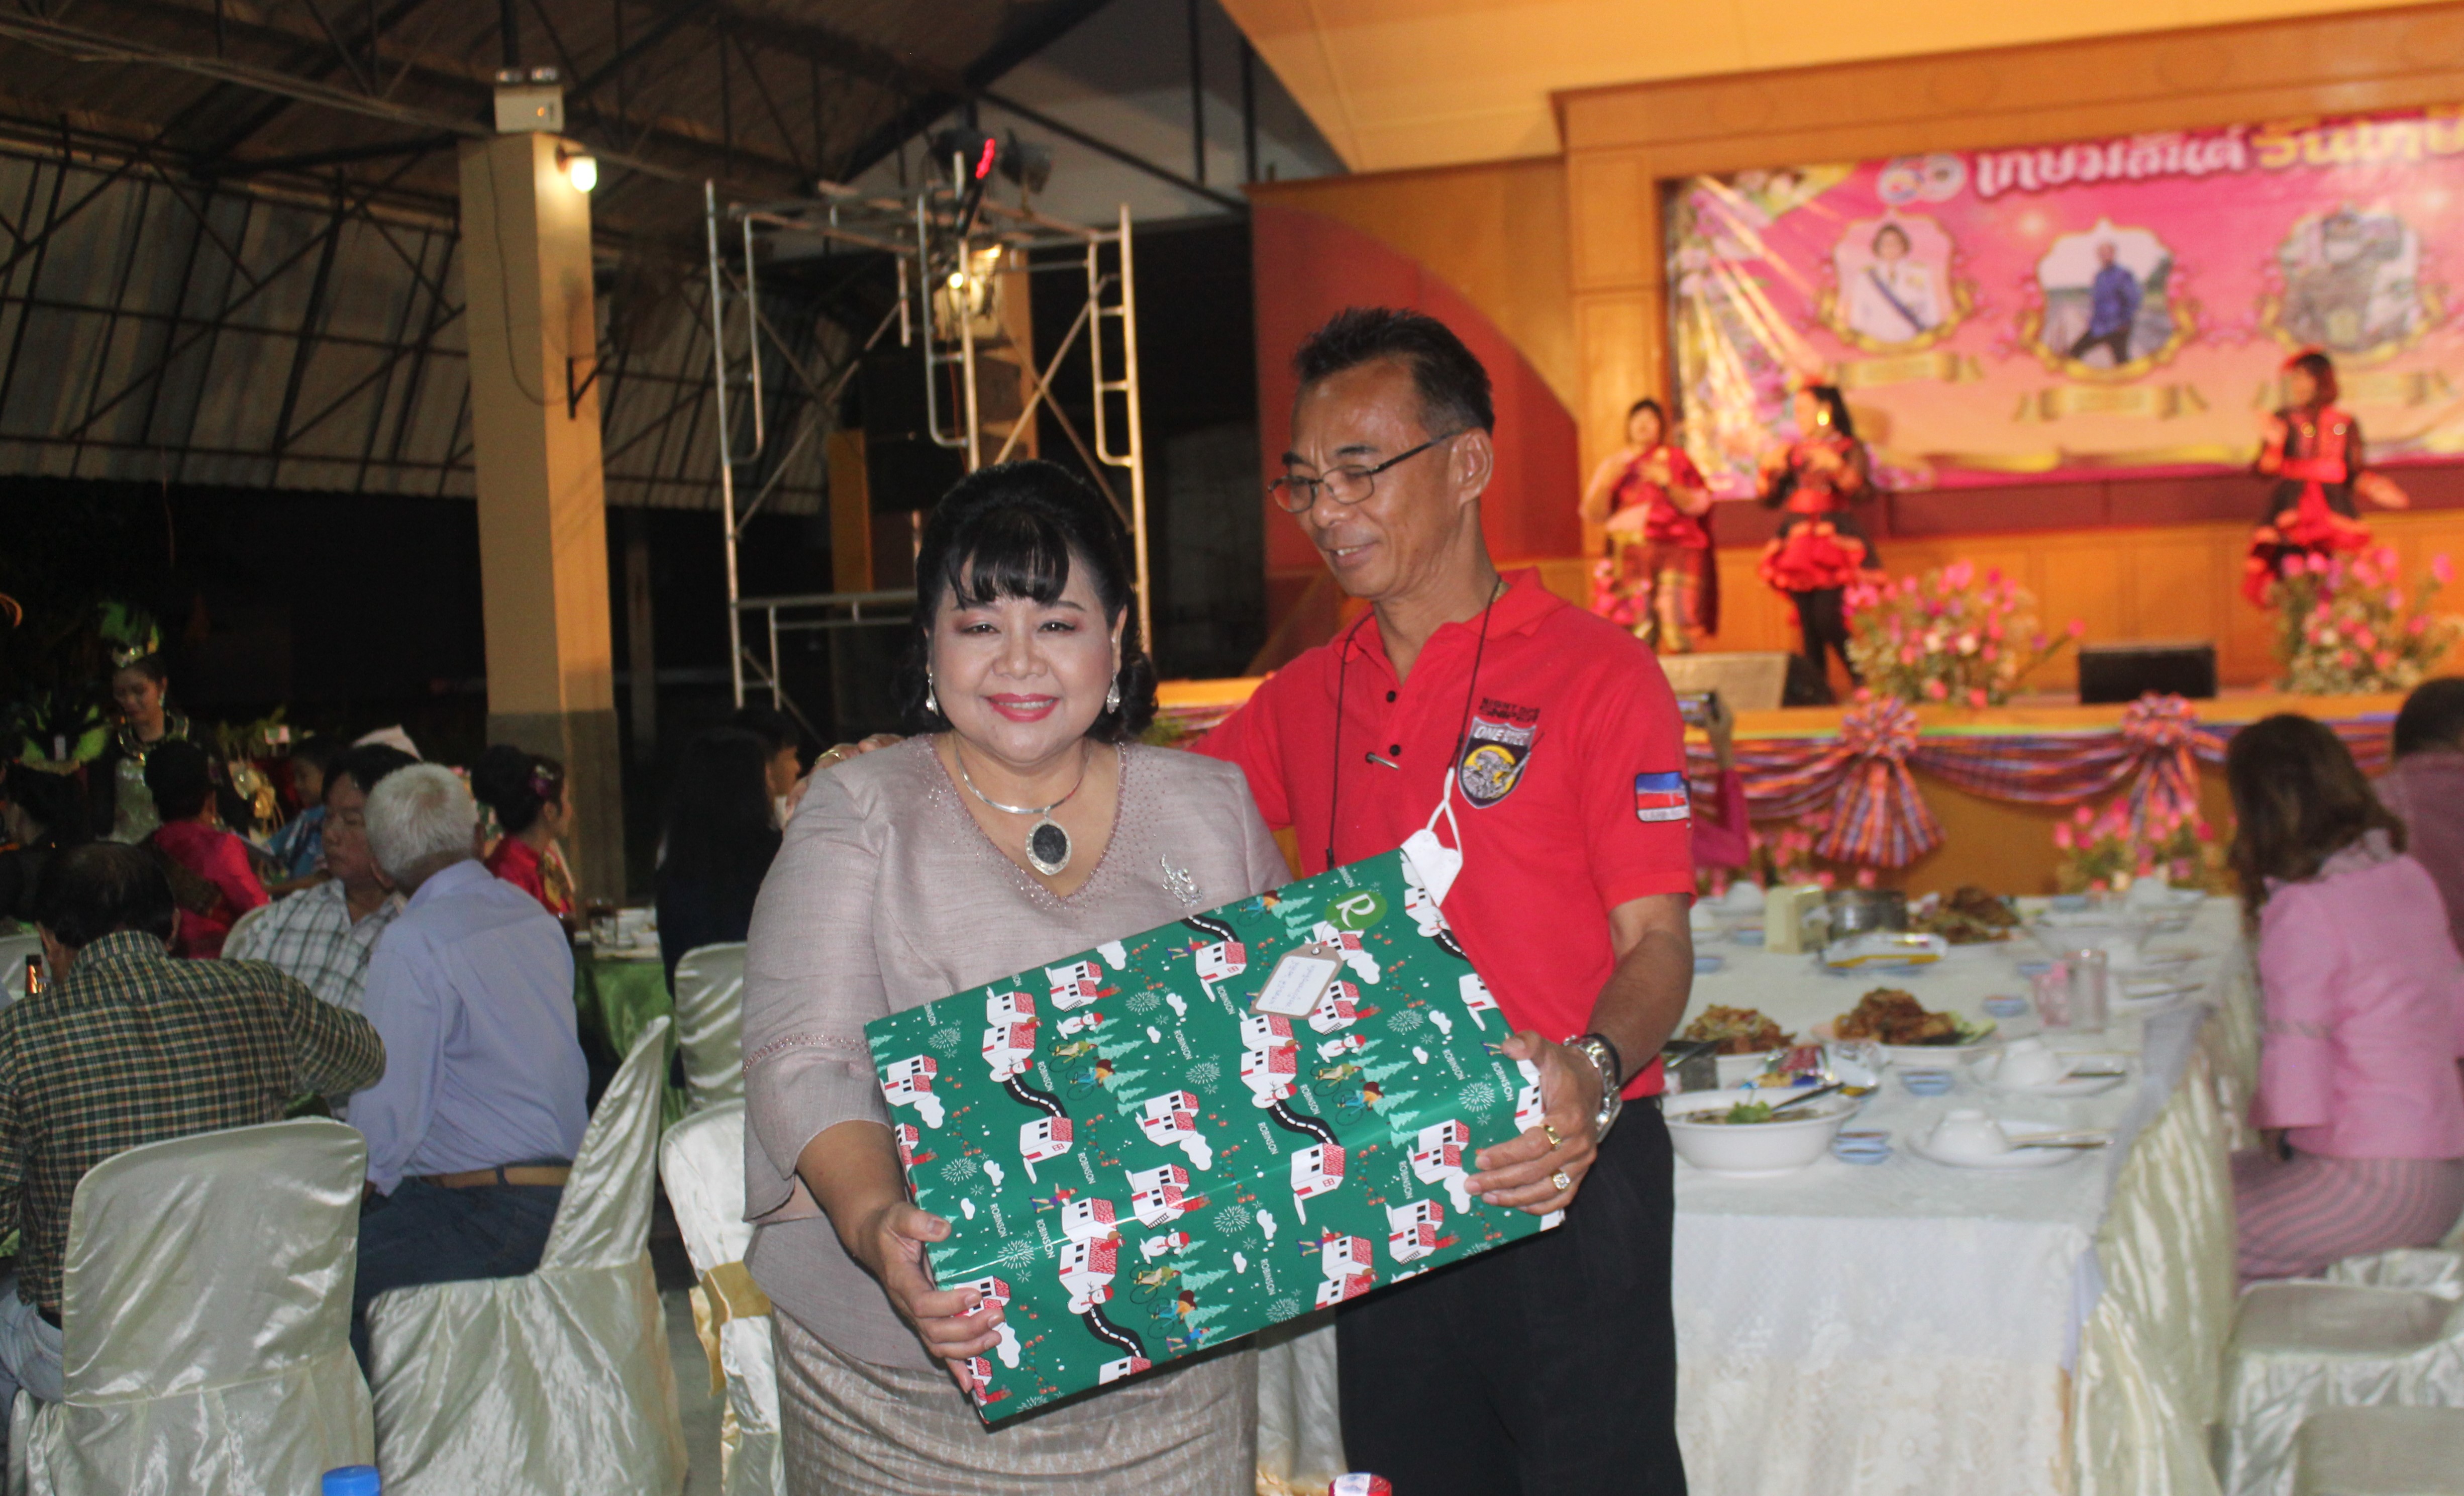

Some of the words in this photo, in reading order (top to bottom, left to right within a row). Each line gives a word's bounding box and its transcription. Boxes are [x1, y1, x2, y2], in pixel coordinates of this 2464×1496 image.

[1474, 726, 1505, 741] ONE
[1216, 985, 1235, 1015] ROBINSON
[1173, 1030, 1192, 1060] ROBINSON
[1037, 1061, 1054, 1091] ROBINSON
[1442, 1049, 1465, 1080] ROBINSON
[1491, 1061, 1514, 1102] ROBINSON
[1300, 1084, 1320, 1115] ROBINSON
[1258, 1122, 1279, 1155] ROBINSON
[1078, 1152, 1095, 1184] ROBINSON
[1399, 1161, 1413, 1199] ROBINSON
[990, 1203, 1007, 1238] ROBINSON
[1036, 1219, 1054, 1259] ROBINSON
[1260, 1258, 1276, 1296] ROBINSON
